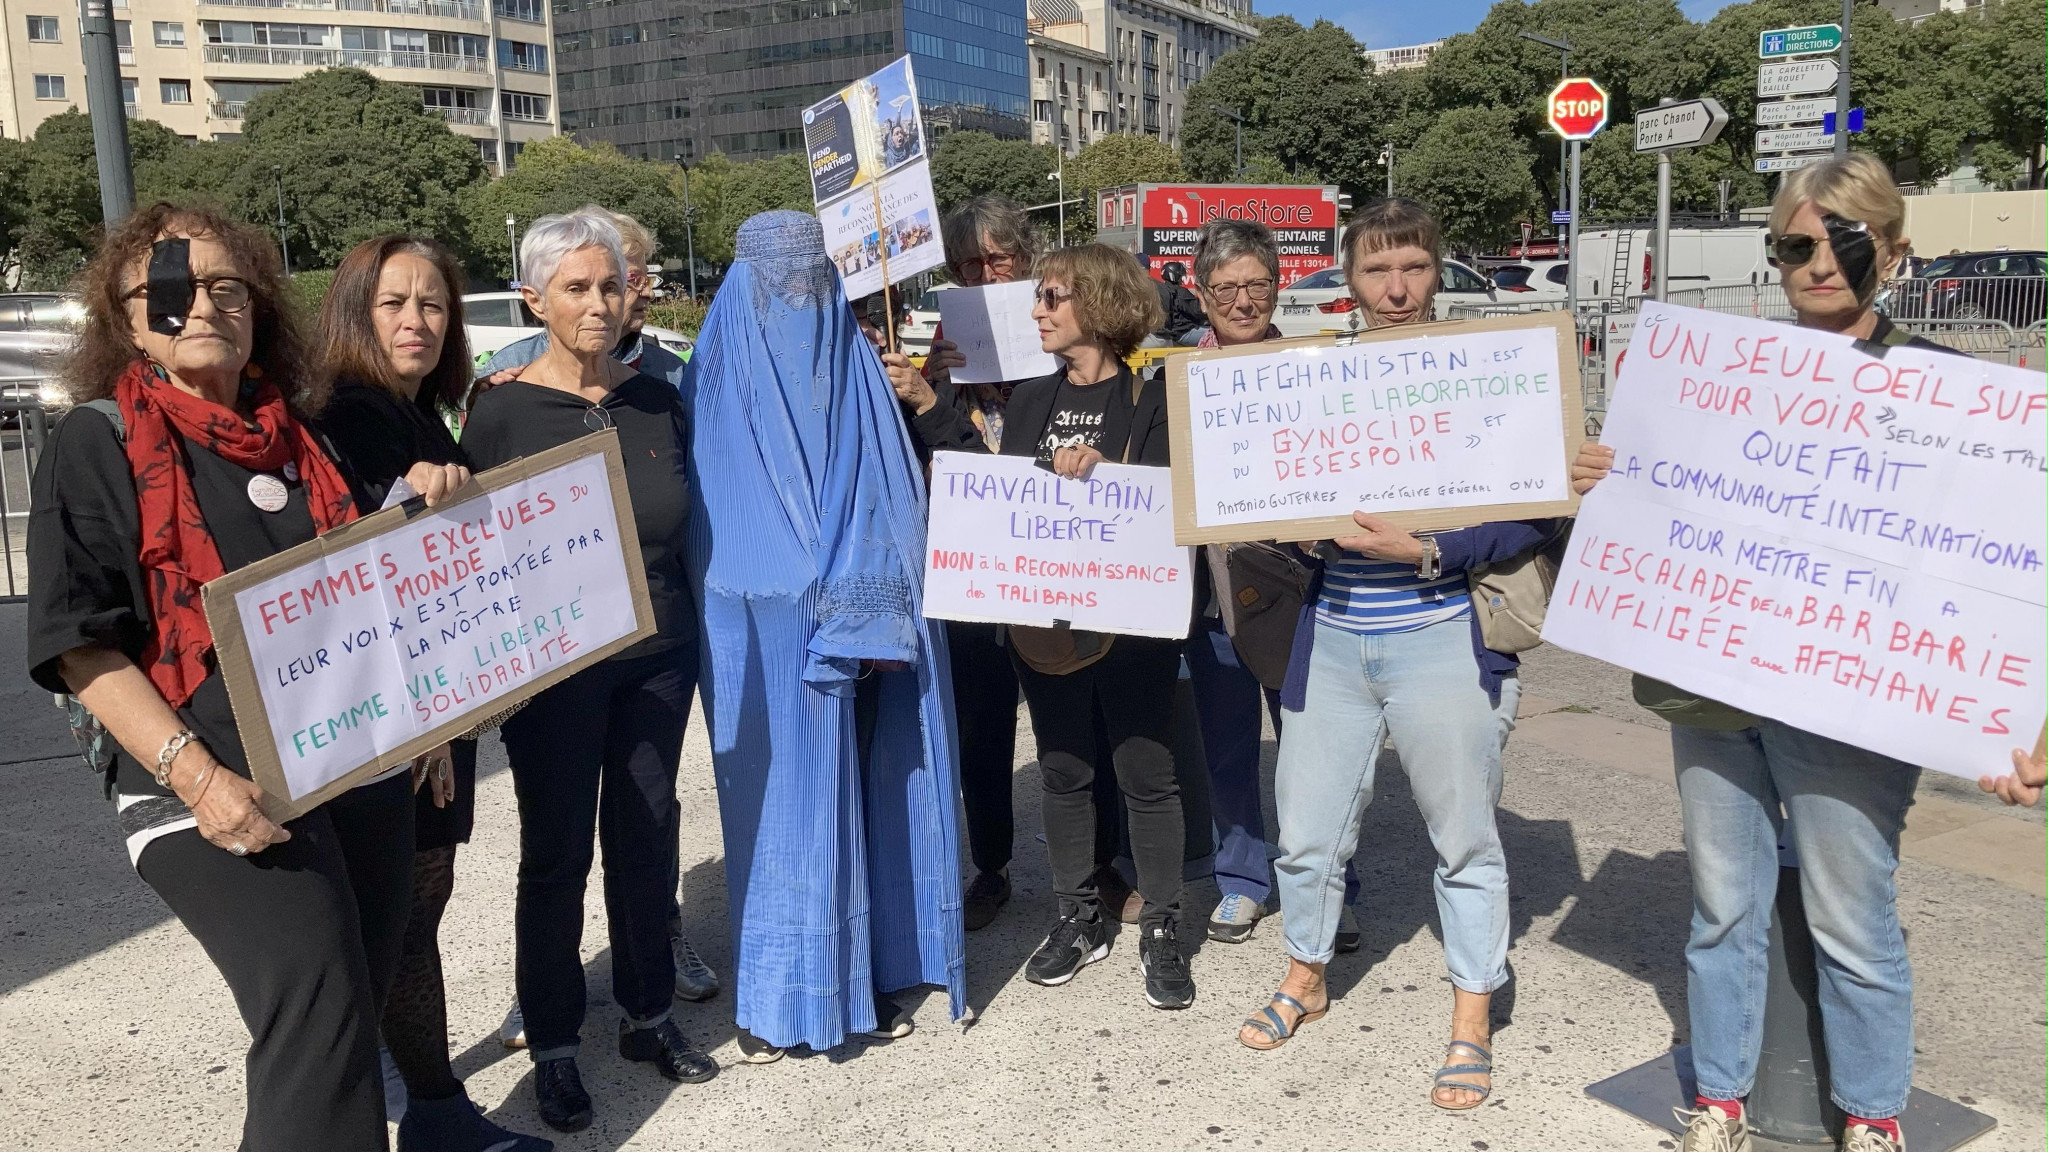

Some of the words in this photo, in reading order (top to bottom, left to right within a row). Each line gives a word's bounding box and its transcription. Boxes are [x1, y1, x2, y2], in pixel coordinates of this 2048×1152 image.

[1786, 30, 1818, 41] TOUTES
[1786, 39, 1834, 52] DIRECTIONS
[1763, 68, 1773, 76] LA
[1779, 63, 1826, 74] CAPELETTE
[1777, 74, 1806, 83] ROUET
[1762, 83, 1791, 92] BAILLE
[1556, 100, 1601, 118] STOP
[1761, 113, 1788, 121] Portes
[1785, 103, 1815, 111] Chanot
[1639, 118, 1659, 133] parc
[1663, 109, 1696, 125] Chanot
[1639, 132, 1663, 145] Porte
[1667, 128, 1673, 141] A
[812, 146, 831, 161] #END
[812, 151, 839, 170] GENDER
[814, 153, 853, 178] APARTHEID
[1199, 198, 1313, 224] IslaStore
[1150, 260, 1161, 269] 48
[1302, 259, 1328, 268] 13014
[1493, 347, 1523, 363] EST
[1722, 336, 1835, 382] SEUL
[1852, 361, 1955, 408] OEIL
[1679, 377, 1753, 416] POUR
[1054, 410, 1104, 426] Aries
[1203, 400, 1300, 430] DEVENU
[1322, 393, 1357, 416] LE
[1233, 439, 1249, 455] DU
[1483, 413, 1507, 427] ET
[1884, 424, 1950, 450] SELON
[1958, 440, 1995, 459] LES
[1743, 429, 1819, 475] QUE
[1233, 465, 1250, 480] DU
[1610, 448, 1642, 480] LA
[1651, 461, 1822, 520] COMMUNAUTÉ
[1217, 498, 1266, 516] Antonio
[1269, 491, 1338, 508] GUTERRES
[1438, 480, 1492, 497] GÉNÉRAL
[1509, 479, 1544, 491] ONU
[259, 553, 398, 634] FEMMES
[422, 492, 556, 563] EXCLUES
[569, 484, 588, 502] DU
[932, 549, 974, 571] NON
[994, 557, 1008, 572] la
[1668, 519, 1724, 557] POUR
[1735, 538, 1831, 587] METTRE
[394, 547, 485, 608] MONDE
[1579, 535, 1753, 607] L'ESCALADE
[1750, 595, 1774, 612] DE
[1773, 604, 1794, 620] LA
[965, 580, 986, 600] des
[277, 648, 330, 687] LEUR
[342, 617, 403, 653] VOIX
[417, 585, 467, 623] EST
[476, 539, 553, 593] PORTÉE
[567, 528, 604, 555] PAR
[407, 638, 430, 659] LA
[441, 595, 521, 644] NÔTRE
[1750, 656, 1788, 675] aux
[1794, 645, 2012, 735] AFGHANES
